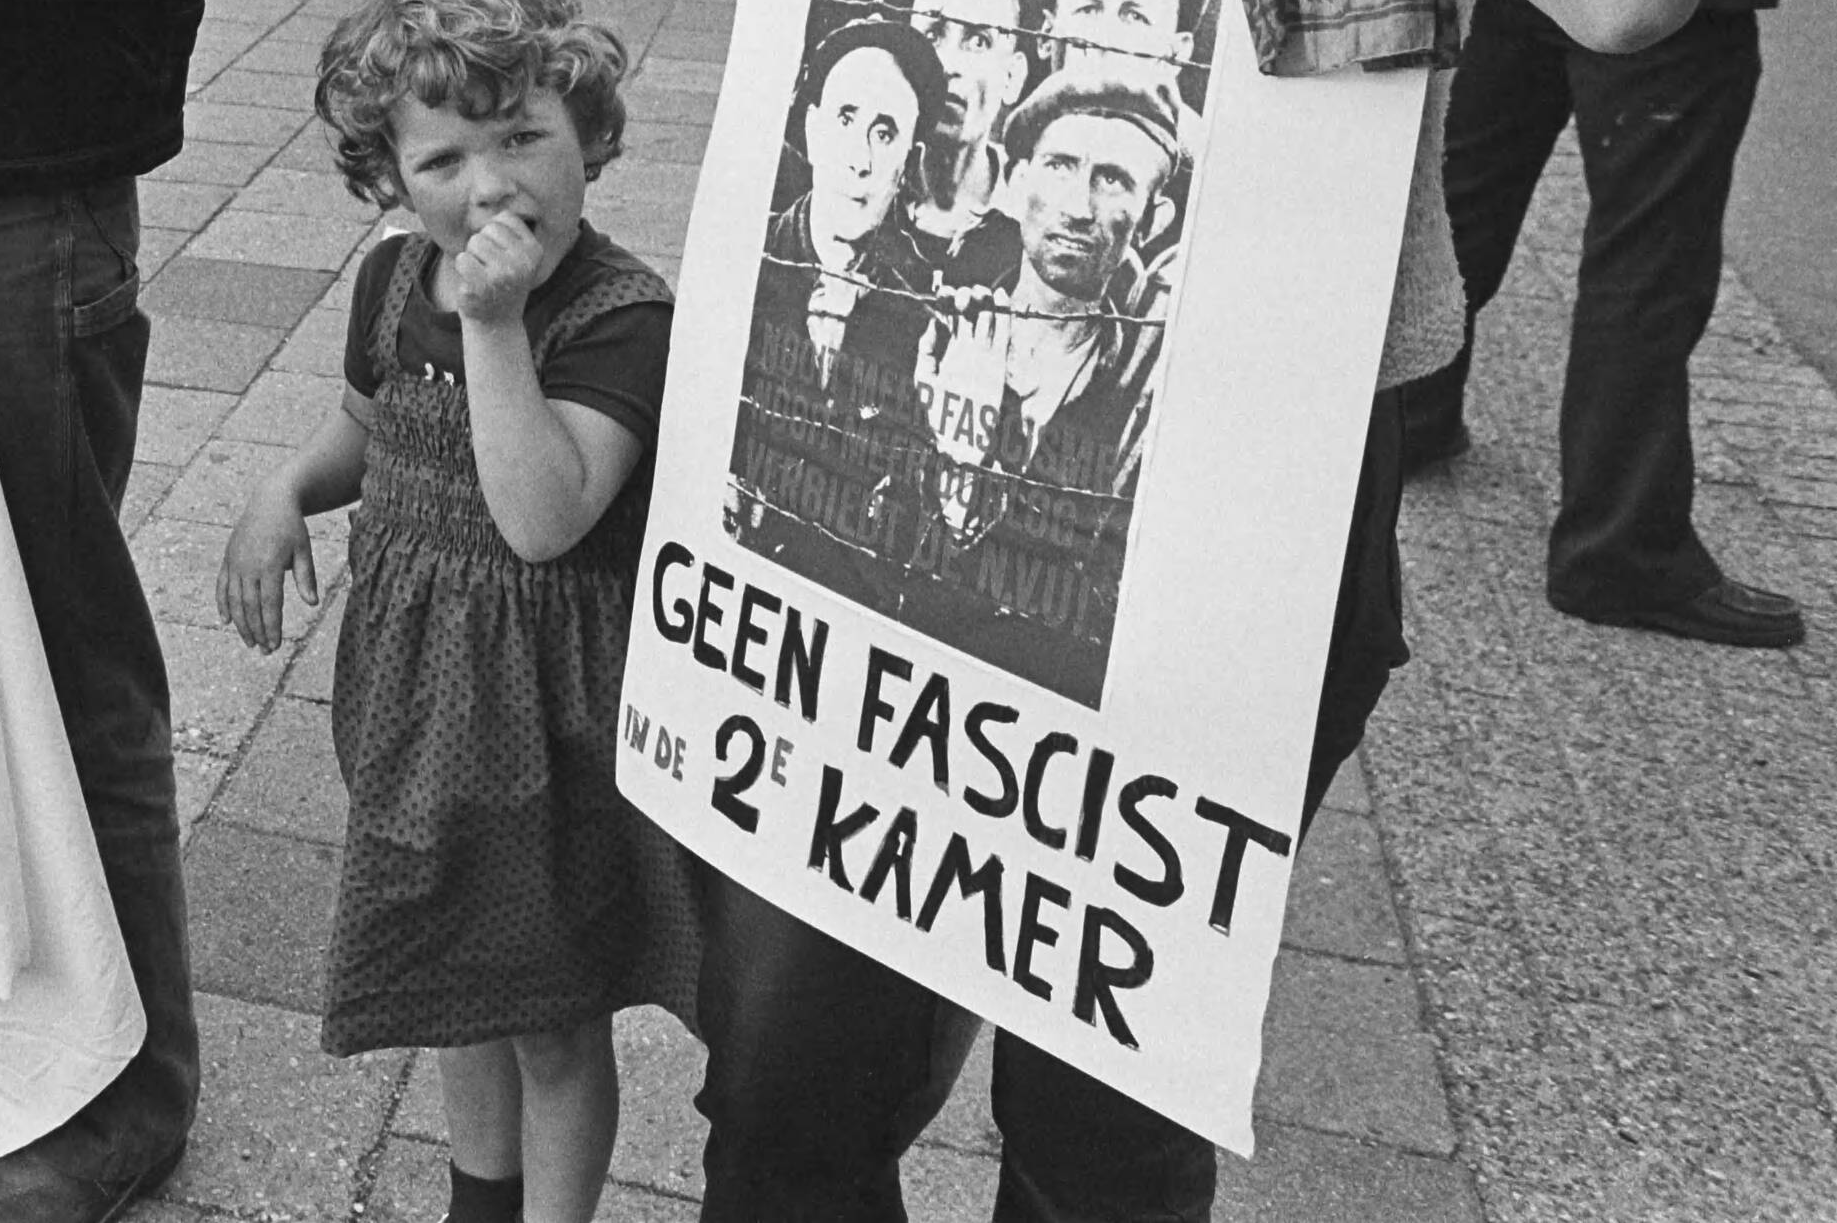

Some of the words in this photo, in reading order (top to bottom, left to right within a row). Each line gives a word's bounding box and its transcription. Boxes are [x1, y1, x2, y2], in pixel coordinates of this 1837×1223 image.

[625, 704, 651, 754] IN
[654, 725, 687, 782] DE
[806, 764, 1154, 1051] KAMER
[652, 540, 829, 723] GEEN
[857, 644, 1292, 935] FASCIST
